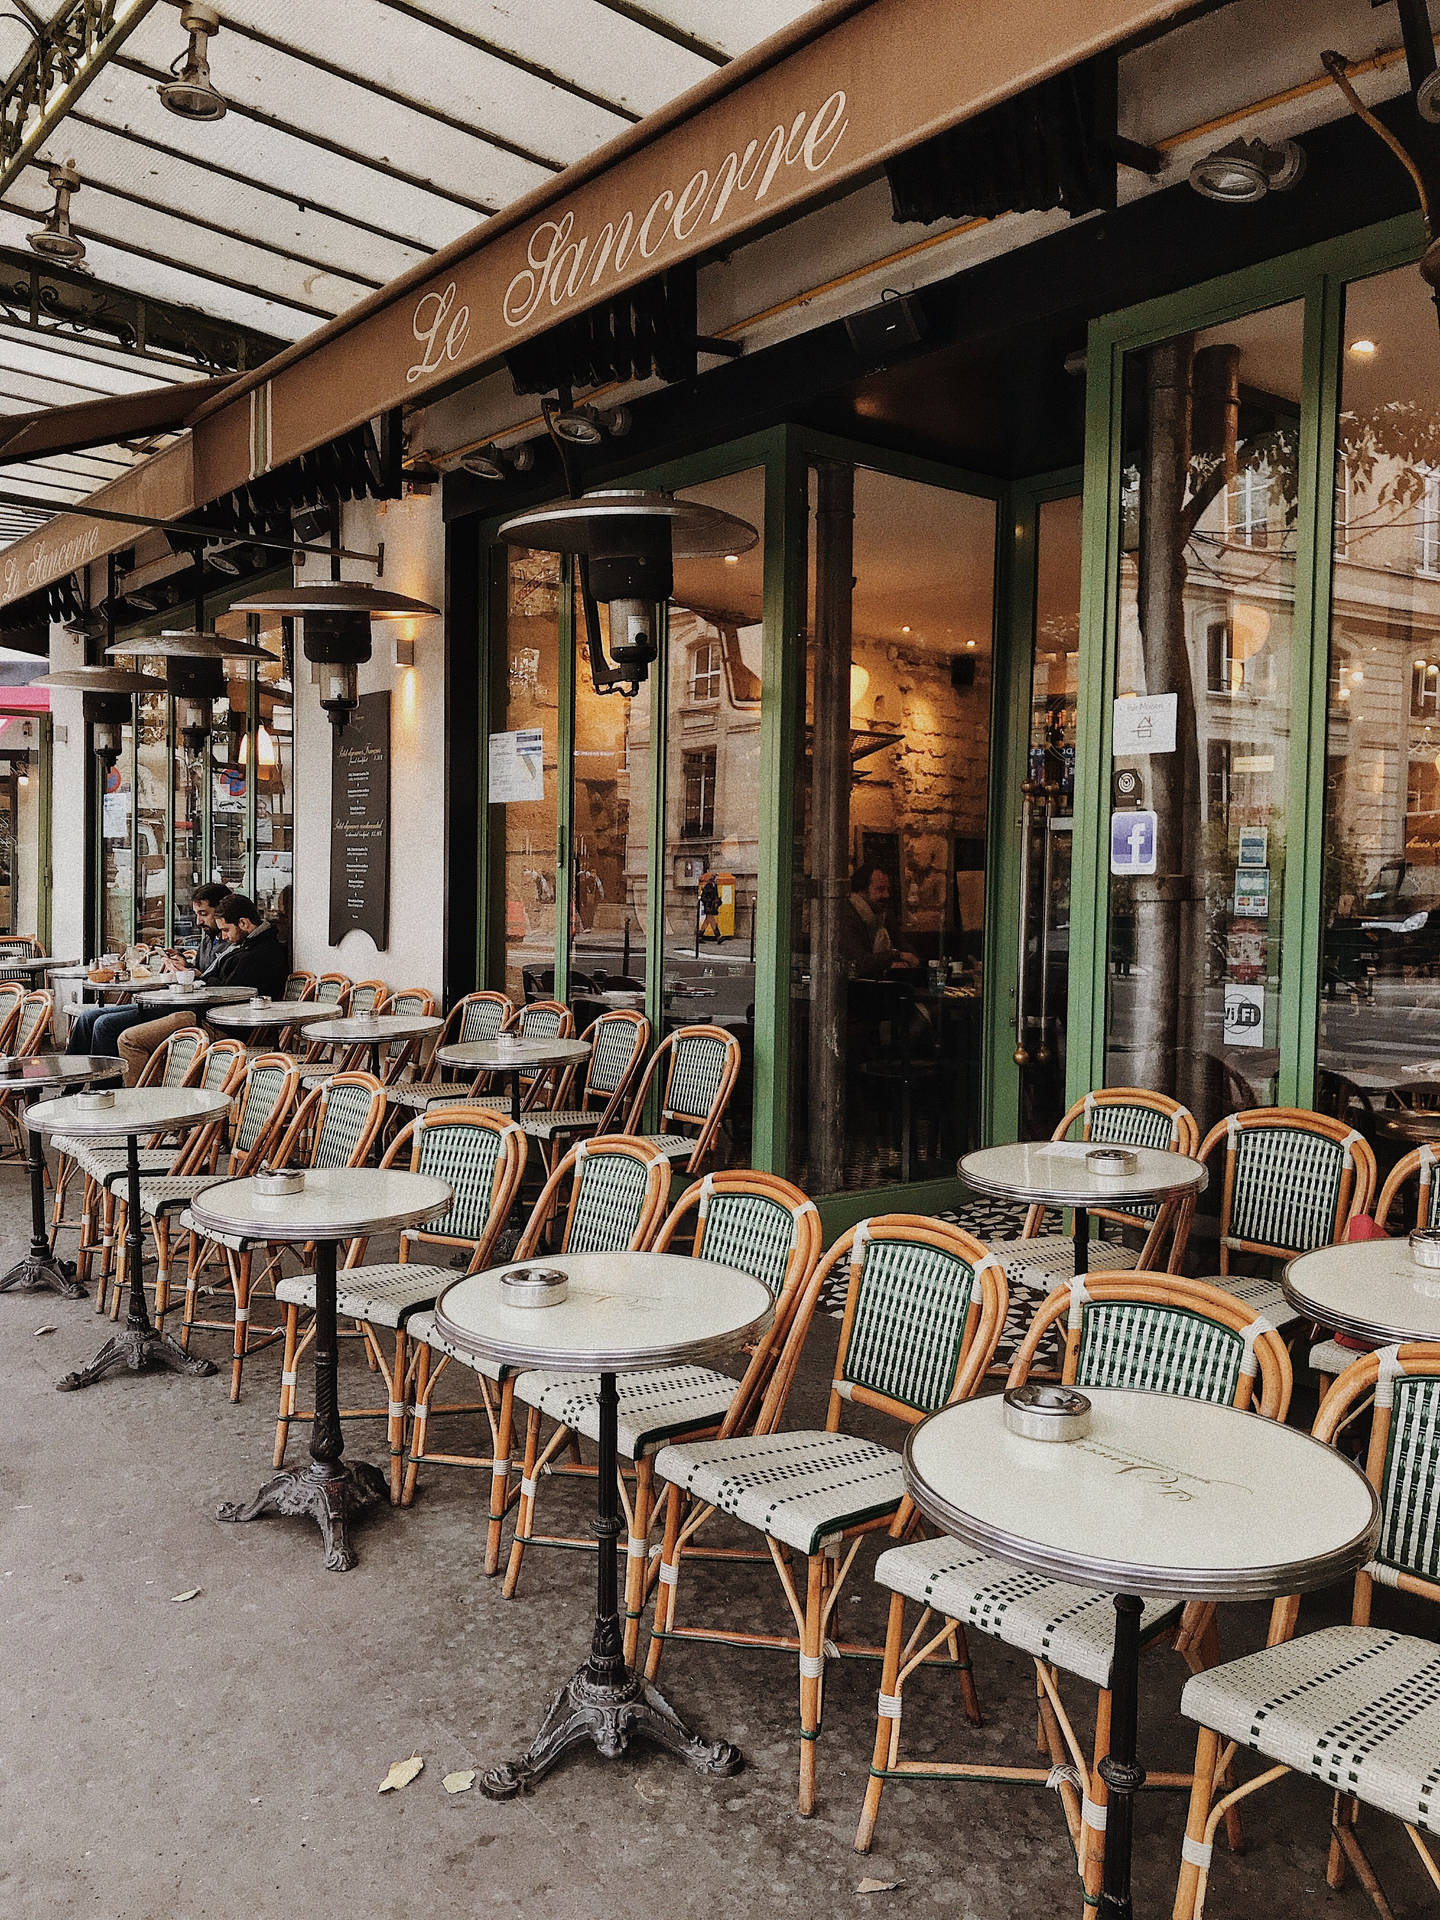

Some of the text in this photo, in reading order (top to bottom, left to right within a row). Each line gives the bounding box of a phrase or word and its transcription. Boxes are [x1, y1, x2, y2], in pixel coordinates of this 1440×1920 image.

[406, 90, 849, 383] Le Sancerre
[3, 526, 99, 600] Le Sancerre
